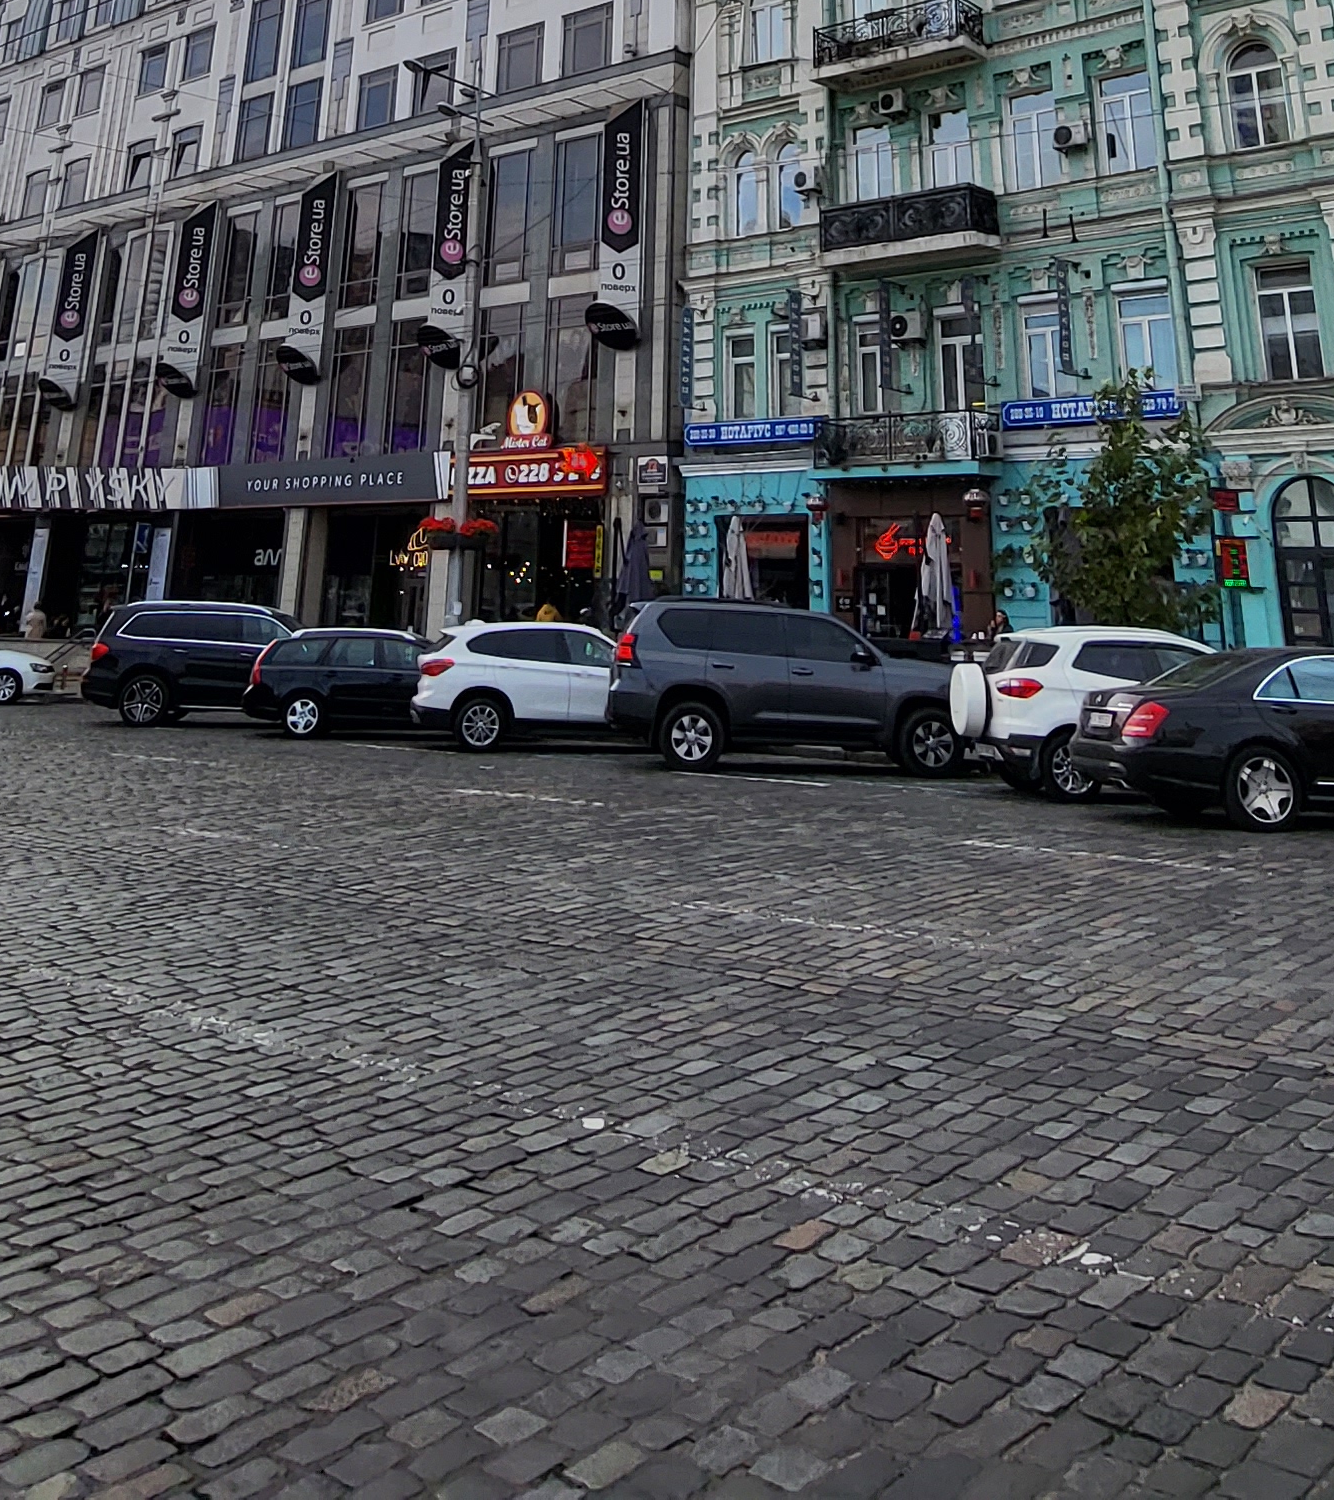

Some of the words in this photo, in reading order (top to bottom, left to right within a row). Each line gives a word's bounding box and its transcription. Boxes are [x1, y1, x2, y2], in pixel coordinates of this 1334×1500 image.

[611, 132, 630, 226] eStore.ua
[444, 169, 466, 255] eStore.ua
[304, 199, 327, 280] eStore.ua
[601, 283, 637, 293] поверх
[720, 424, 771, 440] НОТАРІУС
[501, 436, 531, 450] Mister
[532, 435, 549, 448] Cat
[247, 479, 279, 492] YOUR
[285, 474, 353, 490] SHOPPING
[360, 471, 405, 486] PLACE
[518, 463, 550, 483] 228
